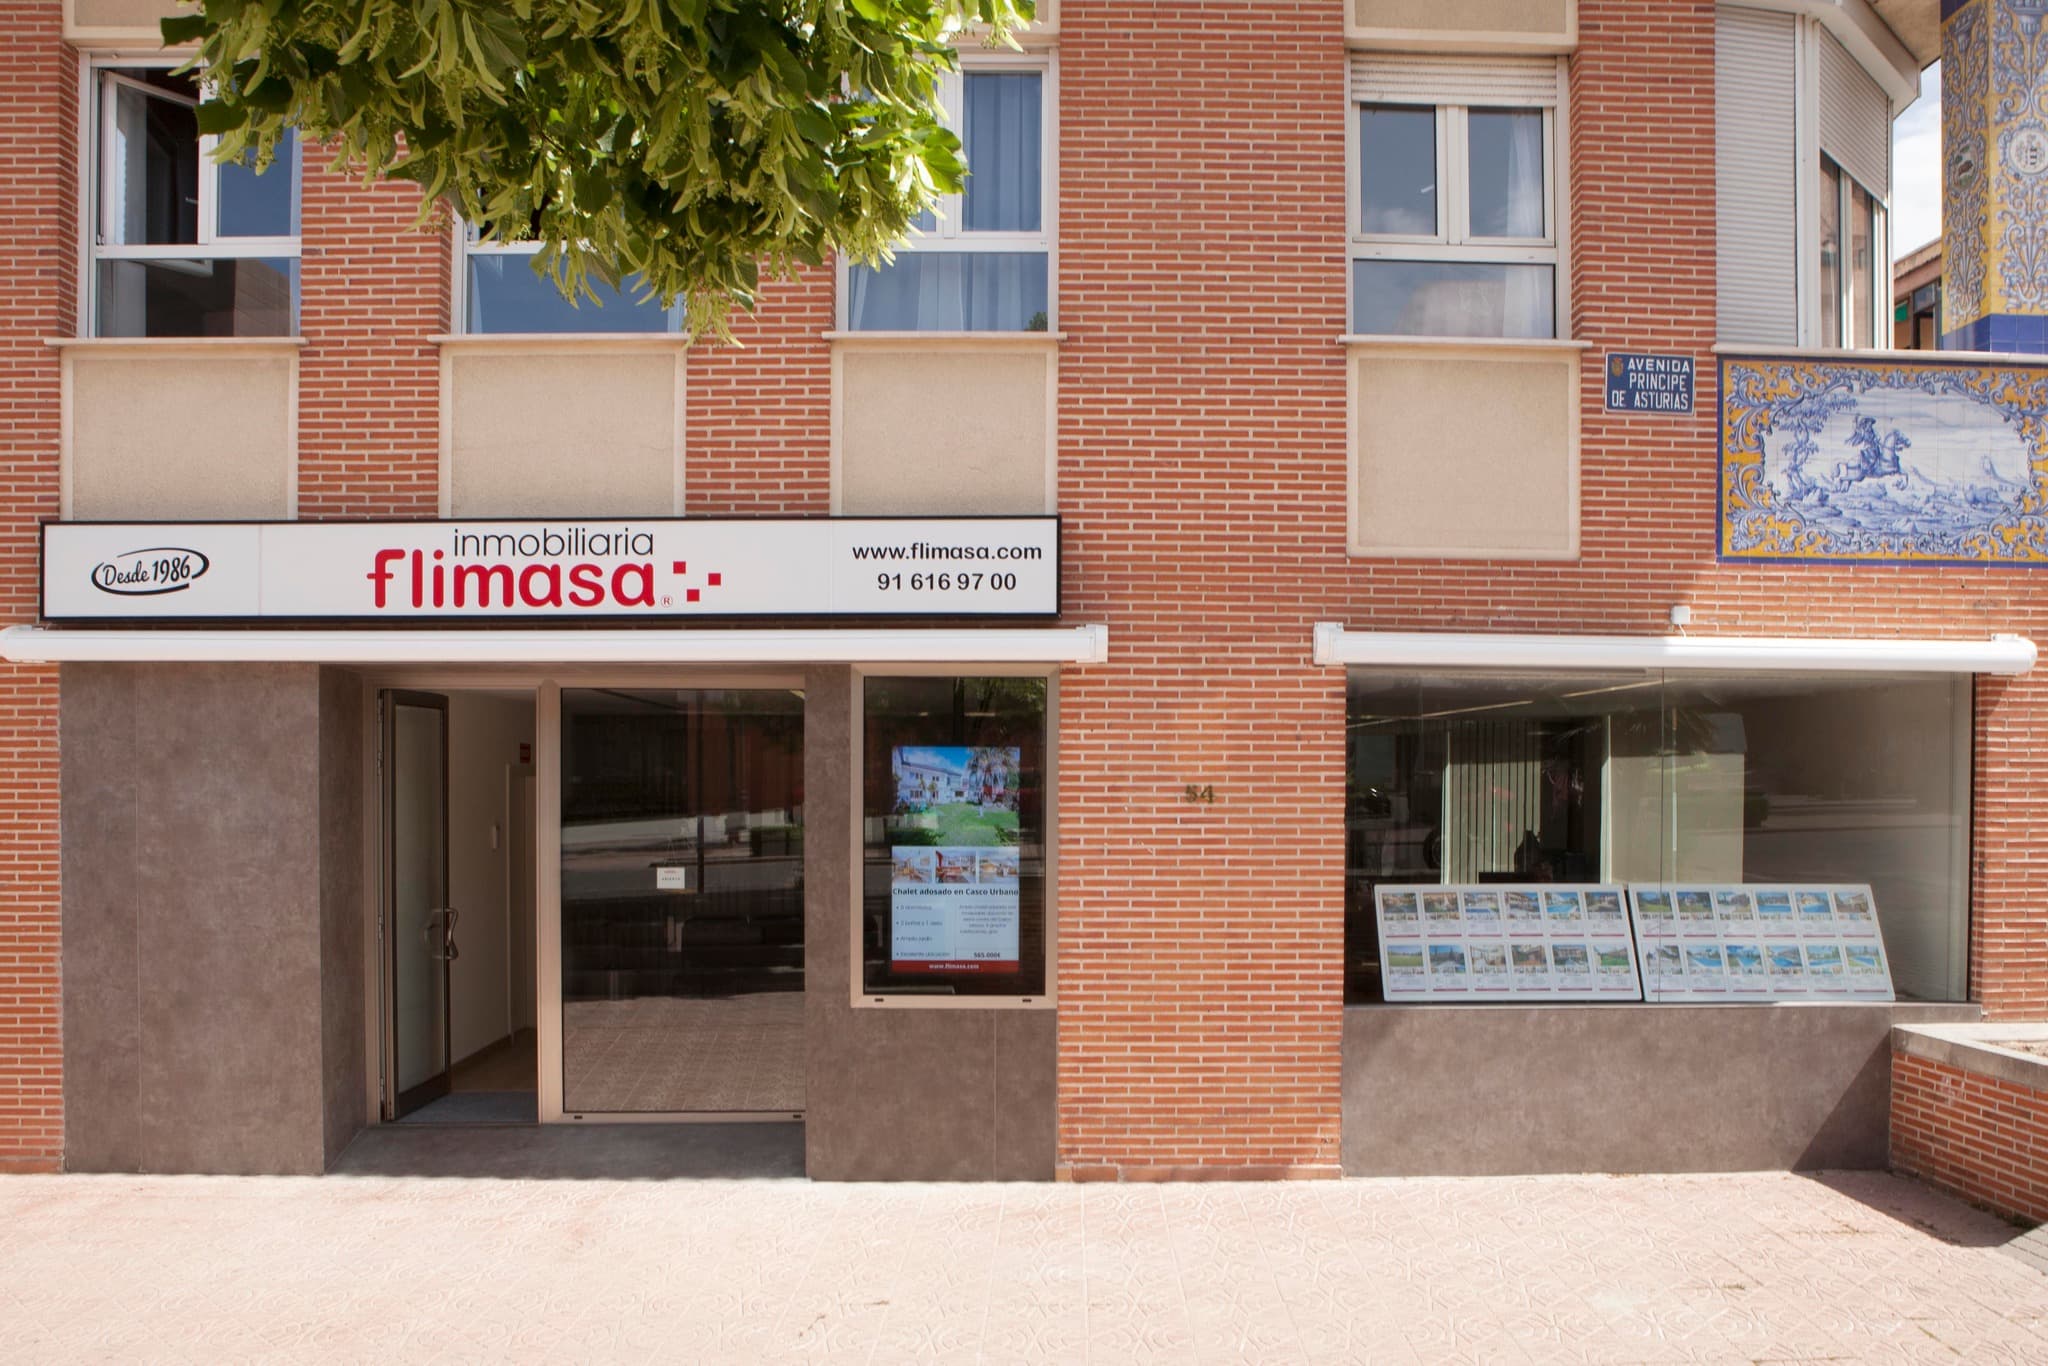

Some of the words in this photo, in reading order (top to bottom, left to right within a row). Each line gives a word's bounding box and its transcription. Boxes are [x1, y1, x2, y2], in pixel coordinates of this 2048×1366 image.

[1627, 357, 1690, 373] AVENIDA
[1629, 372, 1688, 392] PRINCIPE
[1611, 390, 1626, 408] DE
[1633, 391, 1689, 411] ASTURIAS
[453, 527, 654, 557] inmobiliaria
[852, 542, 1042, 560] www.flimasa.com
[102, 560, 150, 586] Desde
[152, 555, 191, 584] 1986
[366, 547, 656, 609] flimasa
[877, 572, 901, 591] 91
[911, 572, 951, 591] 616
[956, 572, 984, 591] 97
[990, 572, 1017, 591] 00
[892, 887, 918, 896] Chalet
[919, 887, 952, 896] adosado
[965, 887, 989, 896] Casco
[989, 887, 1019, 896] Urbano
